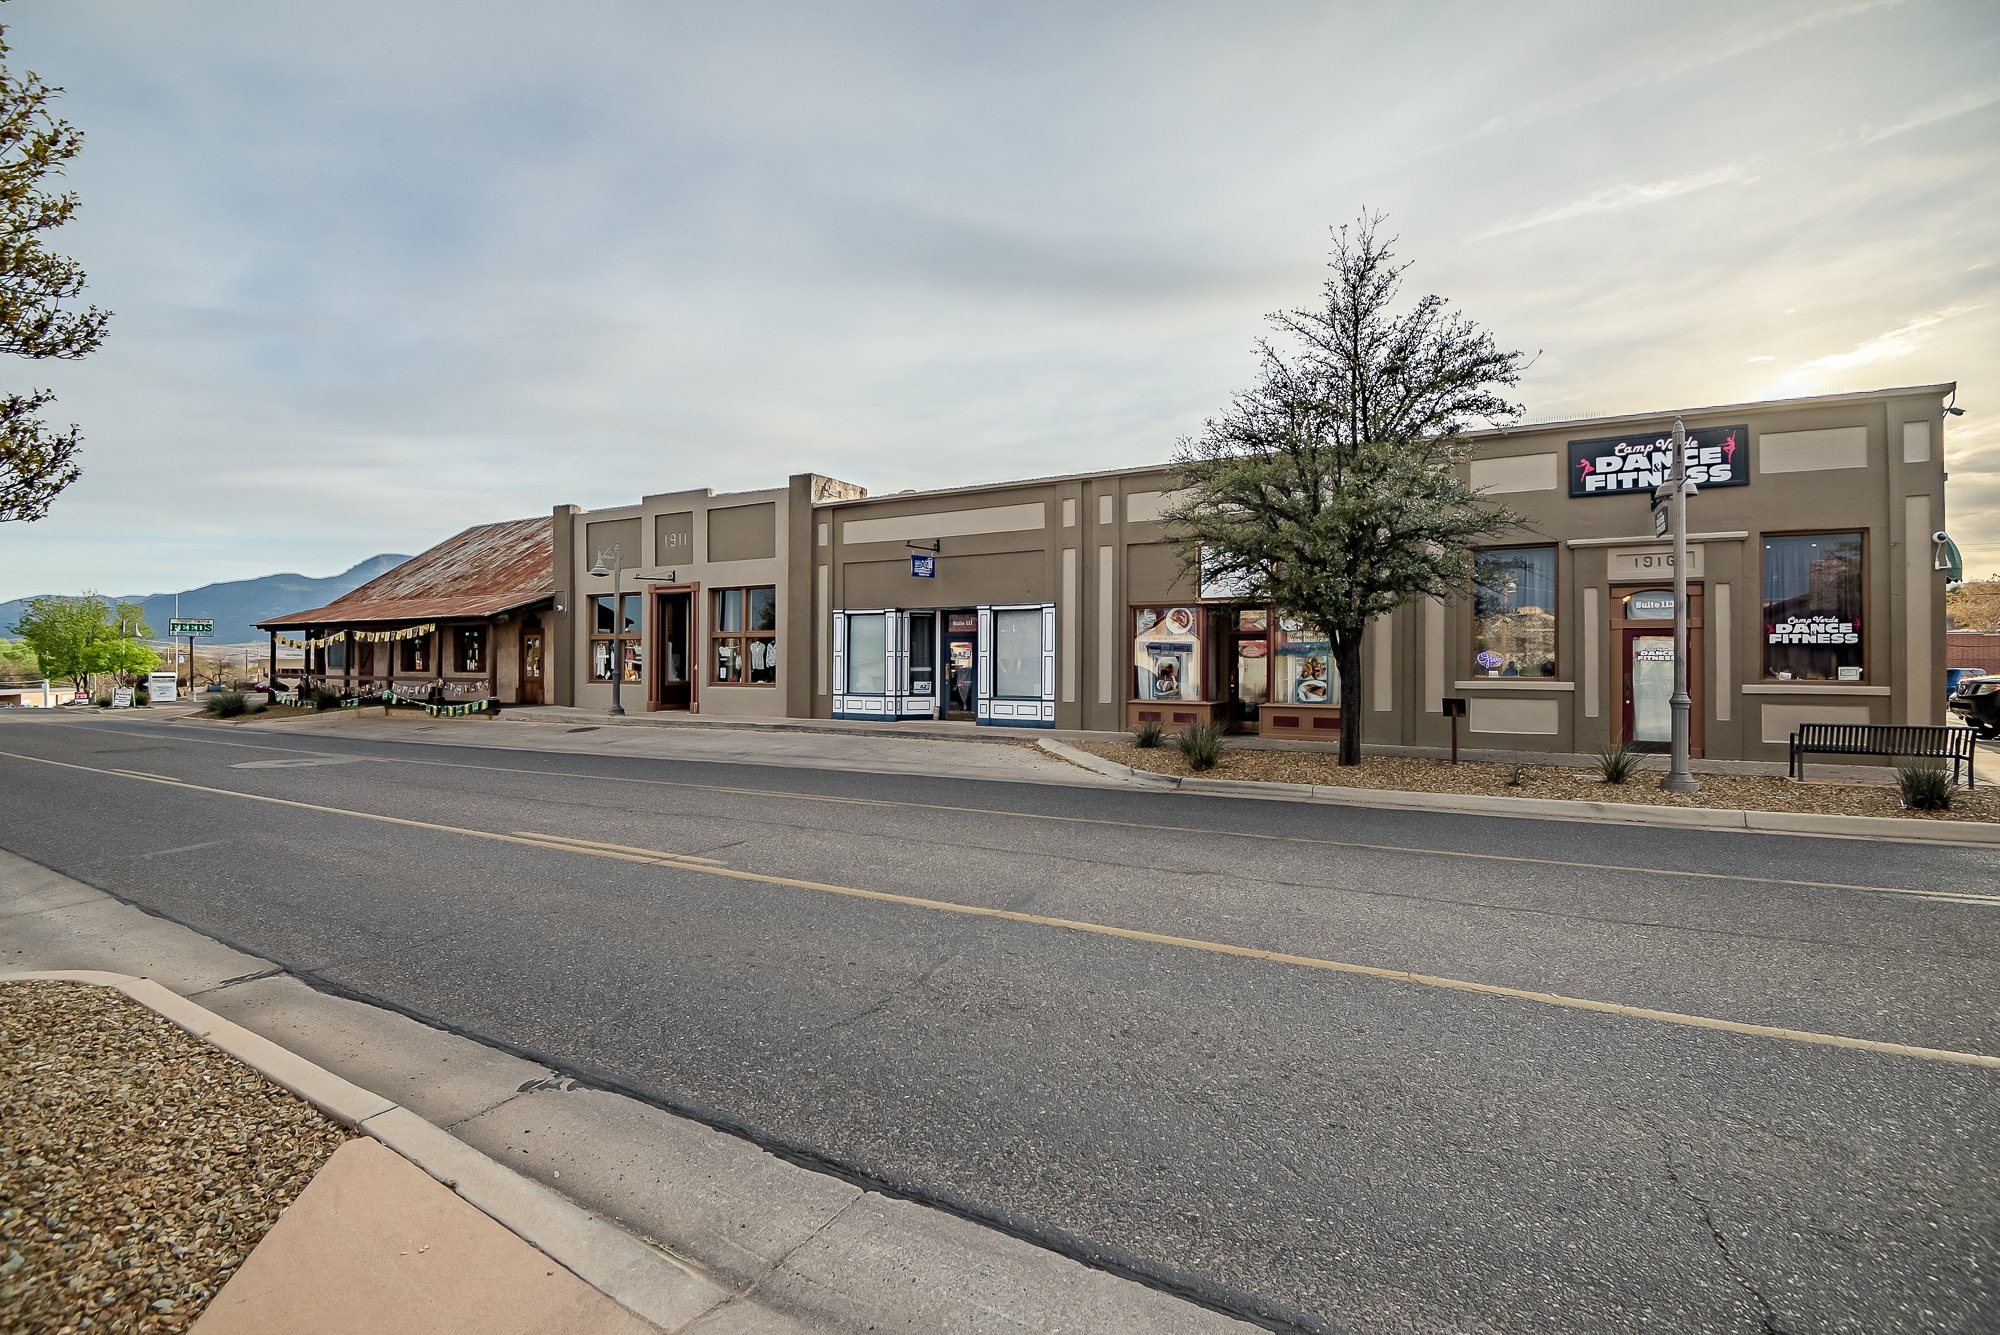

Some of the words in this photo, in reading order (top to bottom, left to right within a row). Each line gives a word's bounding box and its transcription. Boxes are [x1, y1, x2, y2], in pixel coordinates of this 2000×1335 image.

[1614, 442, 1654, 457] Camp
[1655, 436, 1699, 450] Vede
[1653, 462, 1662, 473] &
[1585, 464, 1732, 491] FITNSS
[664, 531, 687, 547] 1911
[1635, 601, 1660, 609] Suite
[1660, 600, 1675, 608] 113
[1787, 616, 1812, 625] Camp
[171, 623, 212, 632] FEEDS
[1775, 623, 1853, 634] DANCE
[1769, 634, 1859, 644] FITNESS
[1476, 651, 1505, 669] Open
